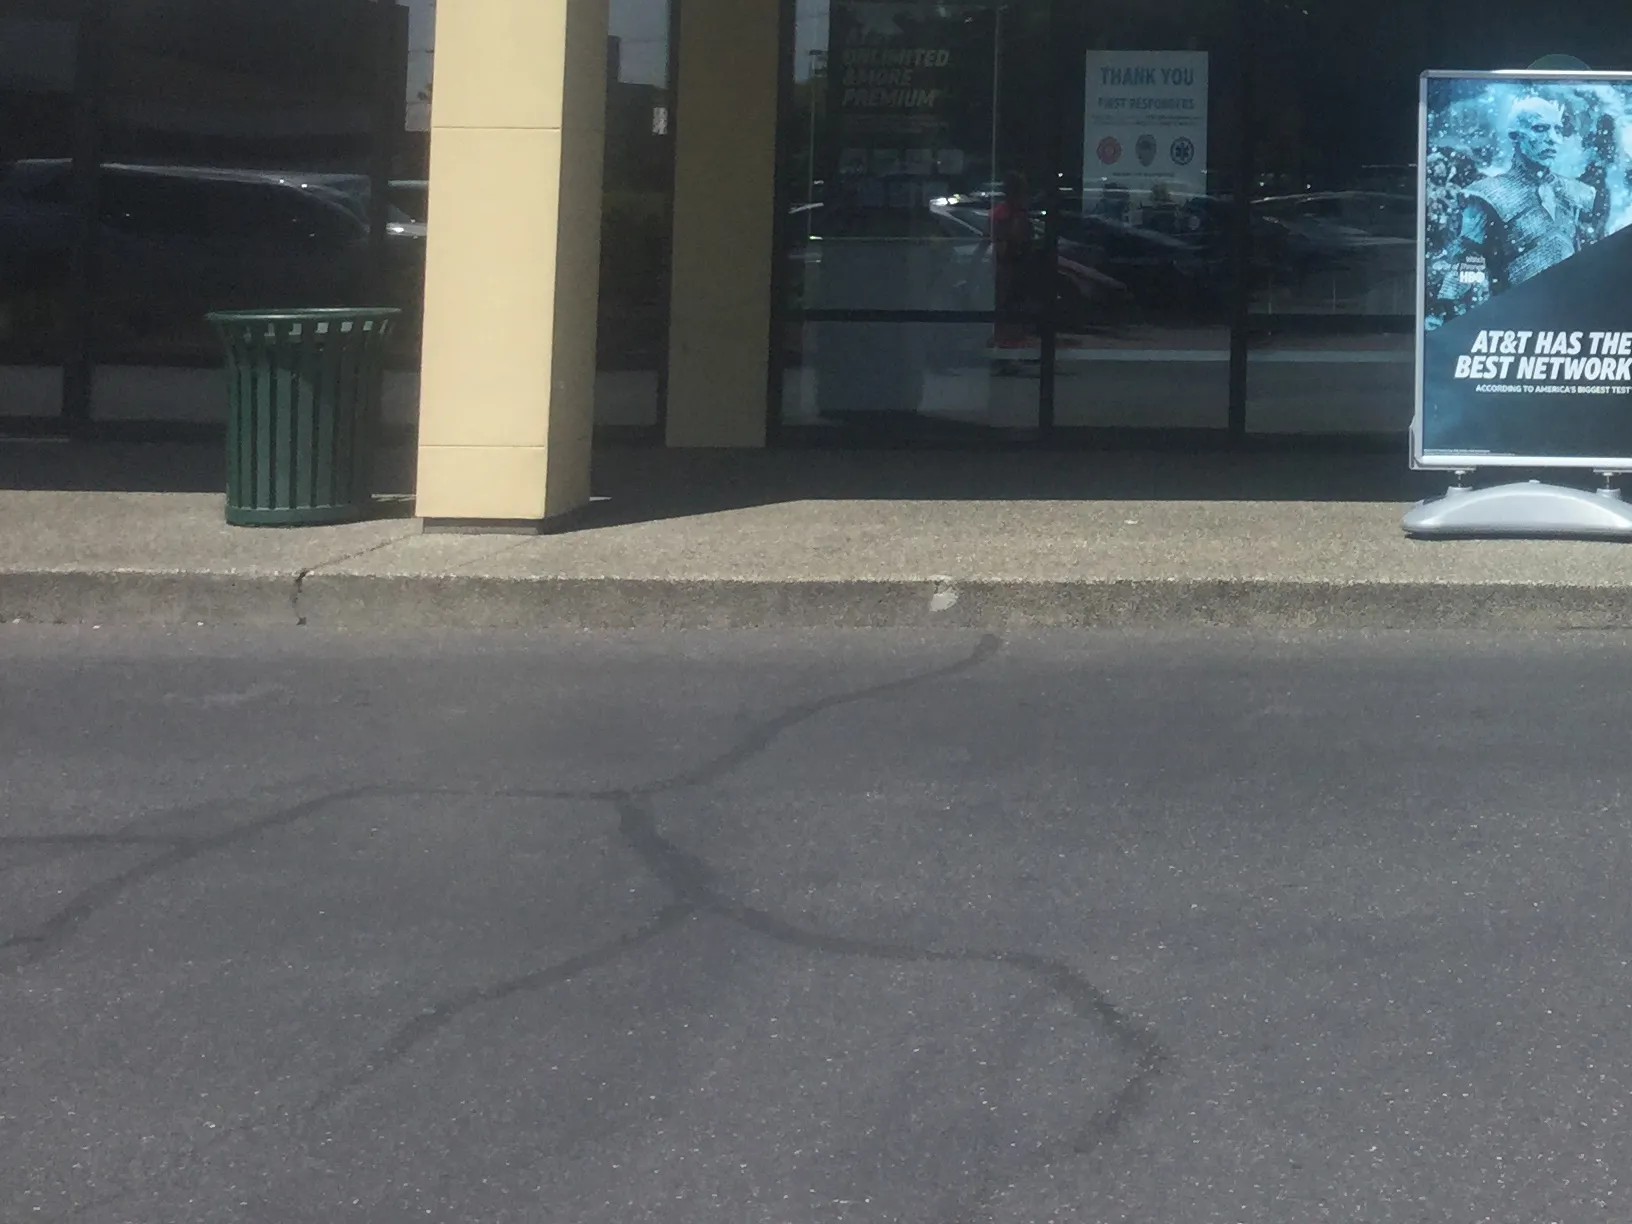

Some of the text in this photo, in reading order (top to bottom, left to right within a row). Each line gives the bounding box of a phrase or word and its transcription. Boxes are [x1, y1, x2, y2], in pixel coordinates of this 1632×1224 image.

[1100, 66, 1194, 86] THANK YOU
[1459, 271, 1485, 284] HBO
[1470, 330, 1533, 354] AT&T
[1534, 331, 1584, 355] HAS
[1453, 355, 1515, 379] BEST
[1475, 384, 1522, 393] ACCORDING
[1523, 385, 1535, 393] TO
[1577, 386, 1610, 394] BIGGEST
